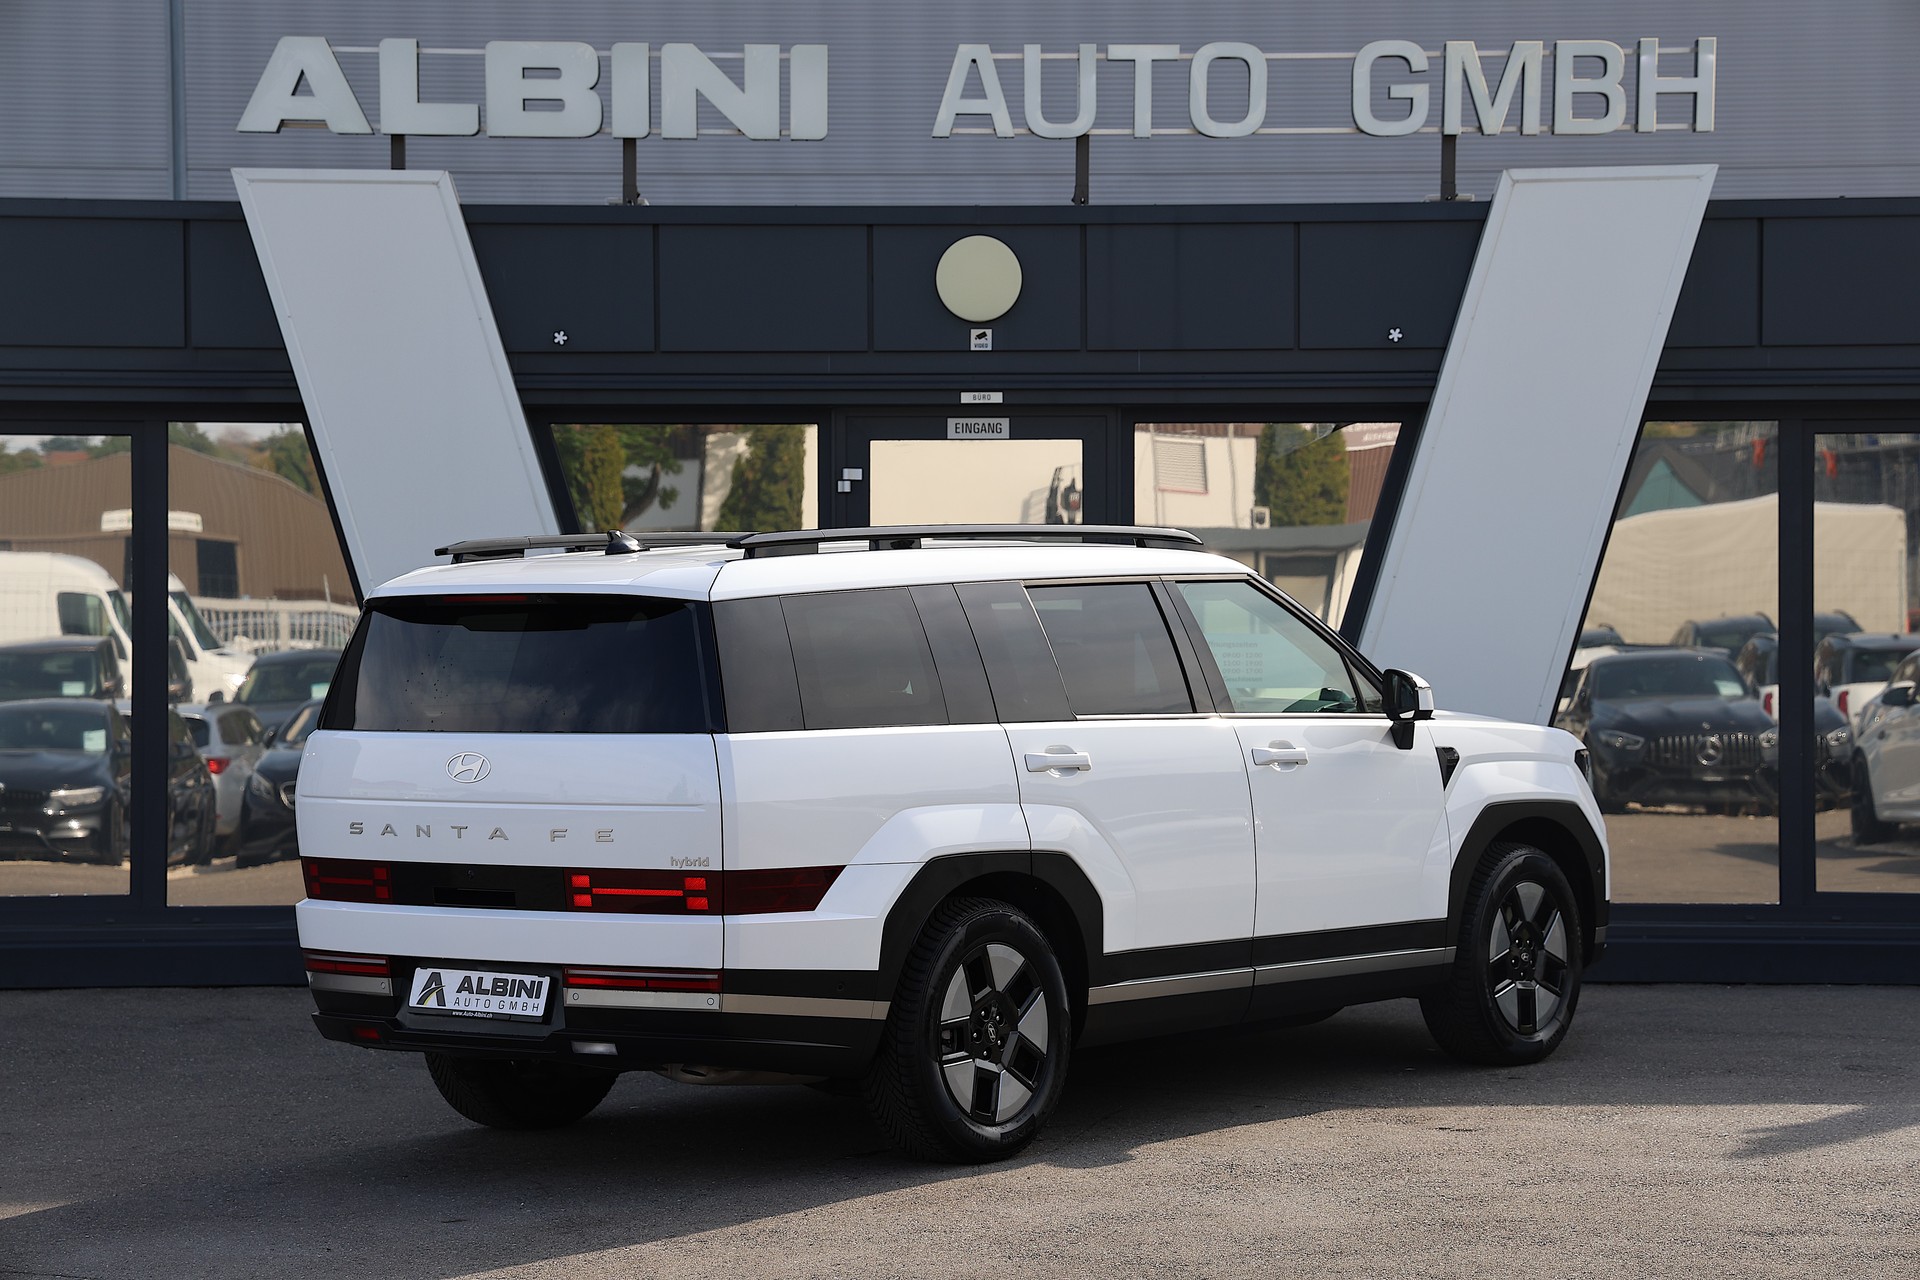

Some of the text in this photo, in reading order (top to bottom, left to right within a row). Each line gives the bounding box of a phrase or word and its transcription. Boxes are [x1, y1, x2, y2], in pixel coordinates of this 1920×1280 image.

[236, 36, 1717, 140] ALBINI AUTO GMBH
[972, 393, 991, 401] BÜRO
[954, 422, 1003, 434] EINGANG
[349, 821, 614, 843] SANTA FE
[670, 856, 710, 868] hybrid
[456, 975, 544, 999] ALBINI
[453, 997, 540, 1012] AUTO GMBH
